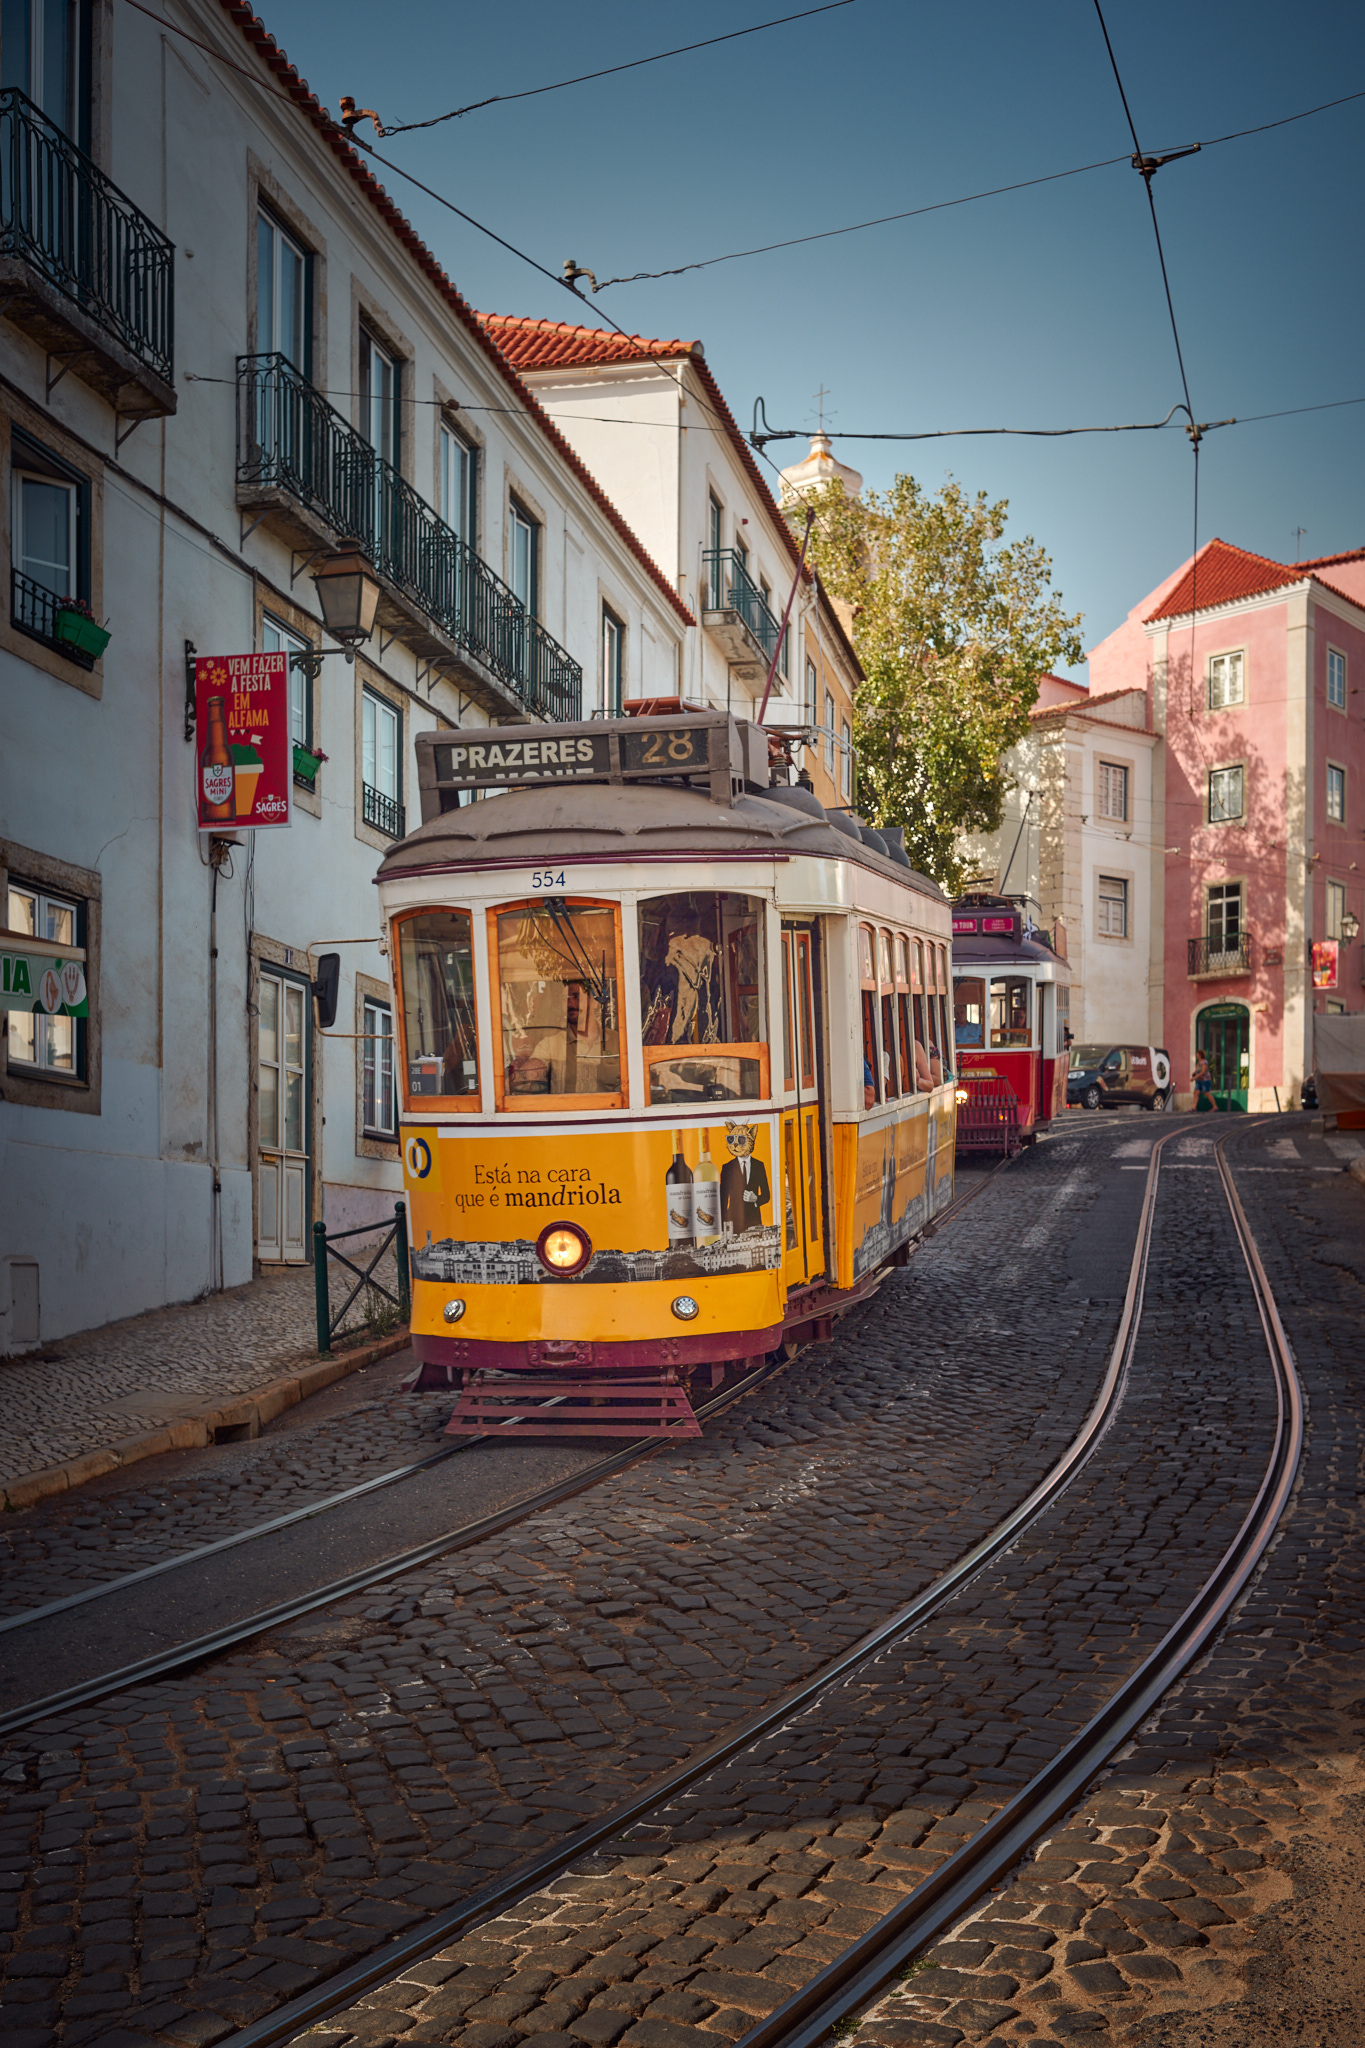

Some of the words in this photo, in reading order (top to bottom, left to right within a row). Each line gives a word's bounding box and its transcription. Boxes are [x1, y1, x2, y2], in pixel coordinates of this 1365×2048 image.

[228, 657, 250, 675] VEM
[252, 654, 284, 674] FAZER
[231, 676, 239, 693] A
[240, 674, 271, 692] FESTA
[234, 693, 250, 711] EM
[228, 708, 269, 729] ALFAMA
[450, 738, 595, 770] PRAZERES
[640, 730, 694, 764] 28
[205, 777, 232, 789] SAGRES
[255, 800, 287, 814] SAGRES
[531, 870, 567, 889] 554
[411, 1066, 422, 1075] 28E
[411, 1081, 422, 1092] 01
[474, 1163, 511, 1184] Está
[517, 1169, 541, 1184] na
[547, 1167, 591, 1182] cara
[455, 1193, 485, 1213] que
[490, 1186, 500, 1207] é
[504, 1182, 622, 1208] mandriola
